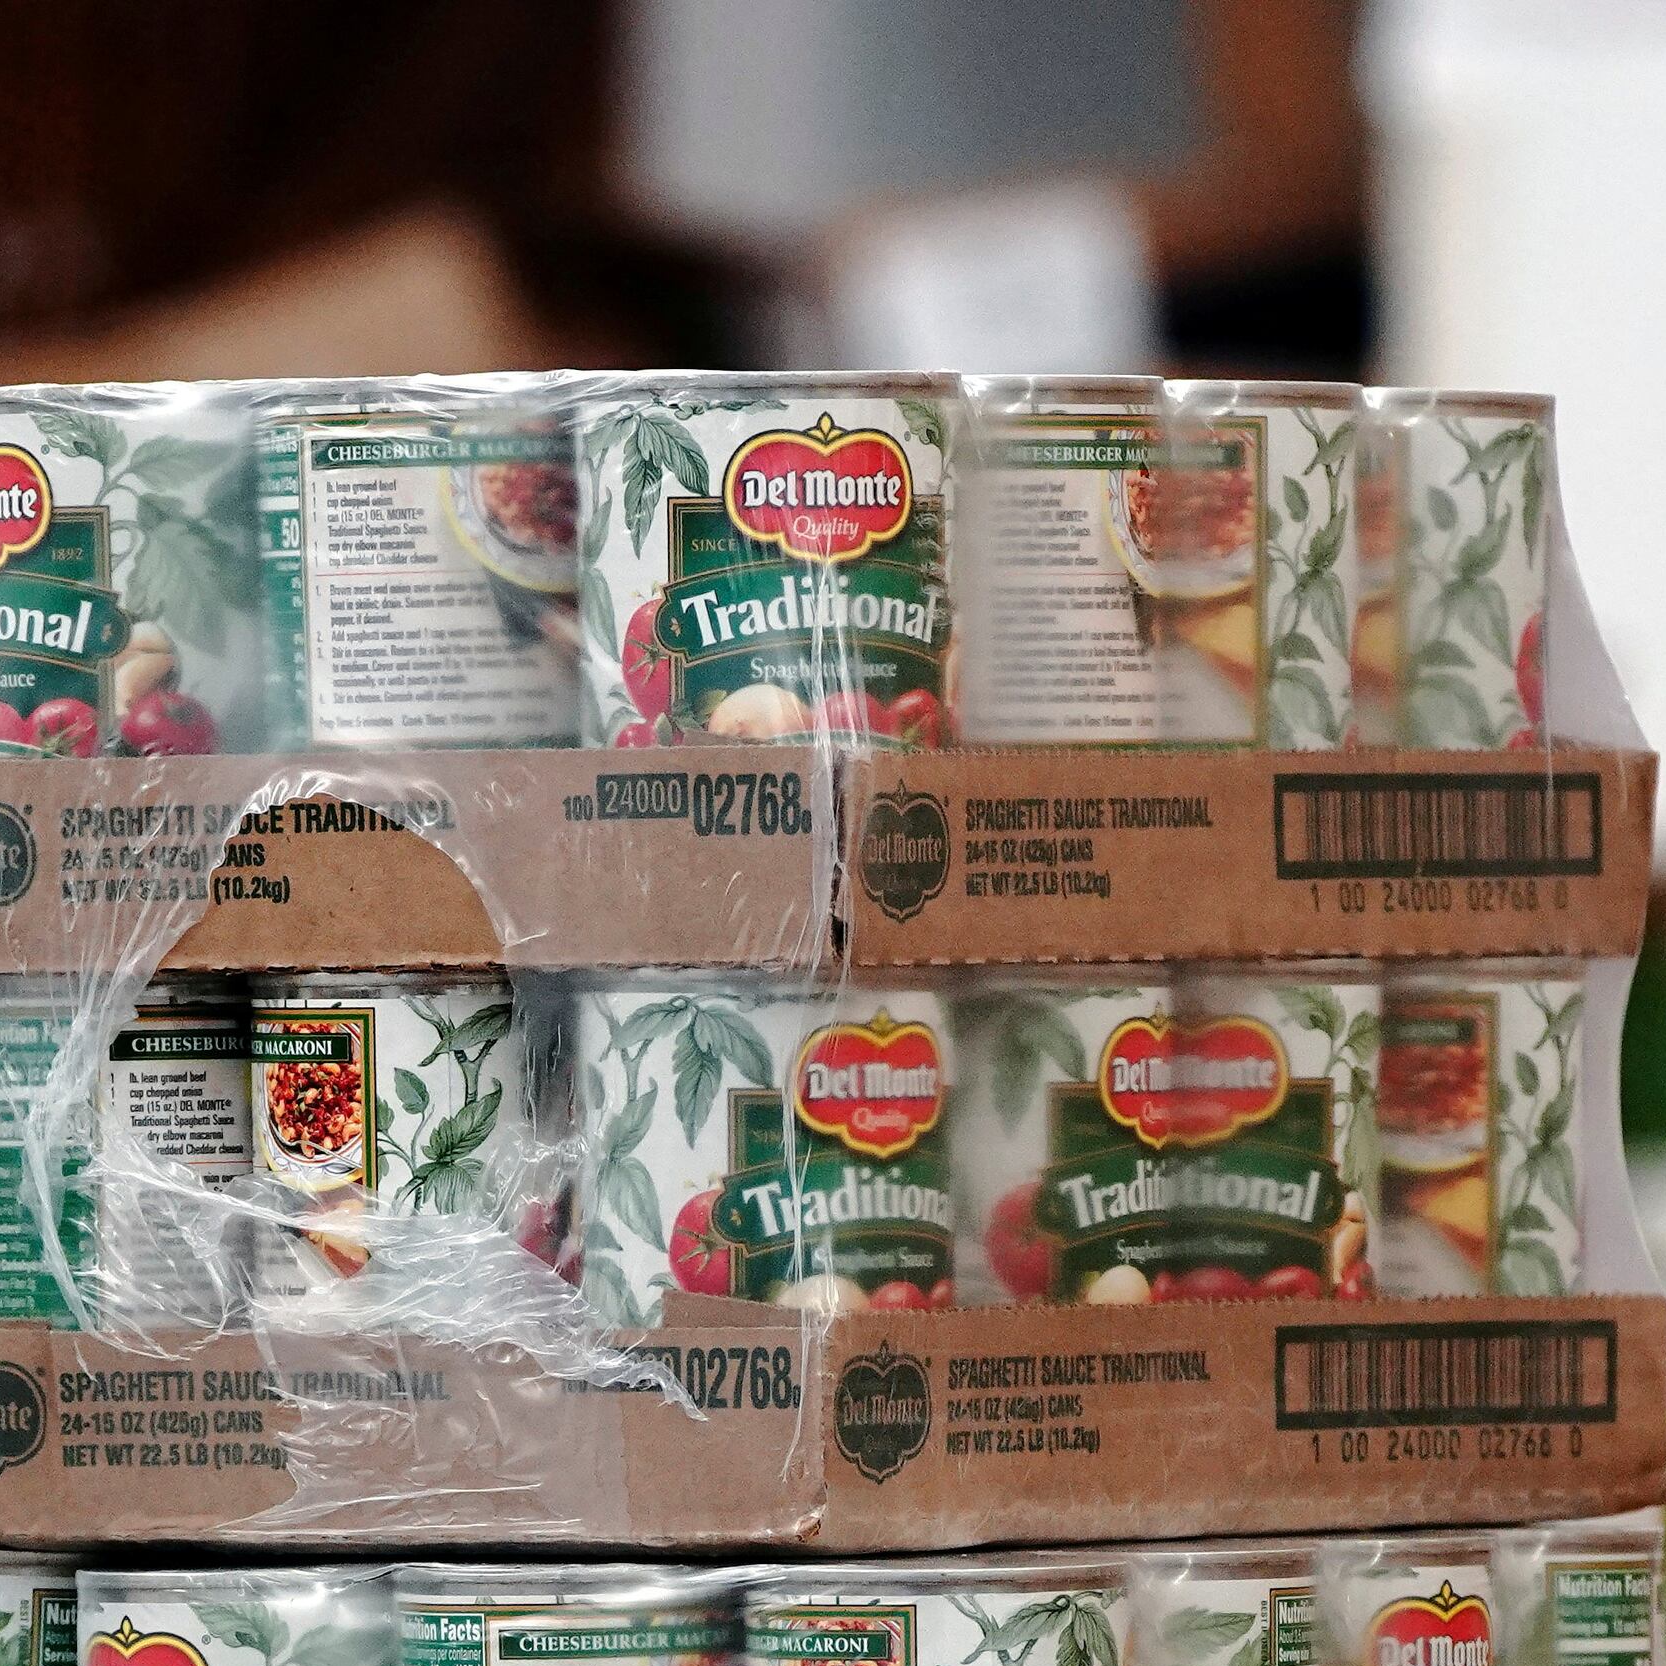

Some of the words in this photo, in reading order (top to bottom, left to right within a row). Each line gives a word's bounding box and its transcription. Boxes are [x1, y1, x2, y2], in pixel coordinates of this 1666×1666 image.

[741, 468, 799, 509] Del
[802, 469, 902, 508] Monte
[793, 514, 860, 541] Quality
[680, 574, 937, 649] Traditional
[604, 776, 683, 817] 24000
[965, 799, 1051, 833] SPAGHETTI
[1053, 797, 1106, 830] SAUCE
[1110, 795, 1214, 829] TRADITIONAL
[214, 875, 291, 904] (10.2kg)
[264, 1039, 333, 1056] MACARONI
[140, 1072, 159, 1084] lean
[160, 1072, 188, 1086] ground
[189, 1071, 207, 1083] beef
[129, 1088, 144, 1100] cup
[145, 1086, 180, 1101] chopped
[129, 1103, 145, 1113] can
[179, 1100, 195, 1112] DEL
[130, 1114, 172, 1128] Traditional
[173, 1114, 212, 1129] Spaghetti
[162, 1129, 187, 1141] elbow
[947, 1358, 1035, 1391] SPAGHETTI
[1040, 1355, 1098, 1388] SAUCE
[1102, 1350, 1212, 1386] TRADITIONAL
[59, 1370, 195, 1404] SPAGHETTI
[202, 1369, 282, 1403] SAUCE
[59, 1411, 116, 1437] 24-15
[121, 1410, 144, 1436] OZ
[213, 1410, 264, 1435] CANS
[62, 1445, 100, 1468] NET
[103, 1444, 135, 1467] WT
[139, 1444, 182, 1467] 22.5
[185, 1444, 209, 1467] LB
[439, 1617, 482, 1643] Facts
[519, 1631, 670, 1653] CHEESEBURGER
[781, 1634, 871, 1654] MACARONI
